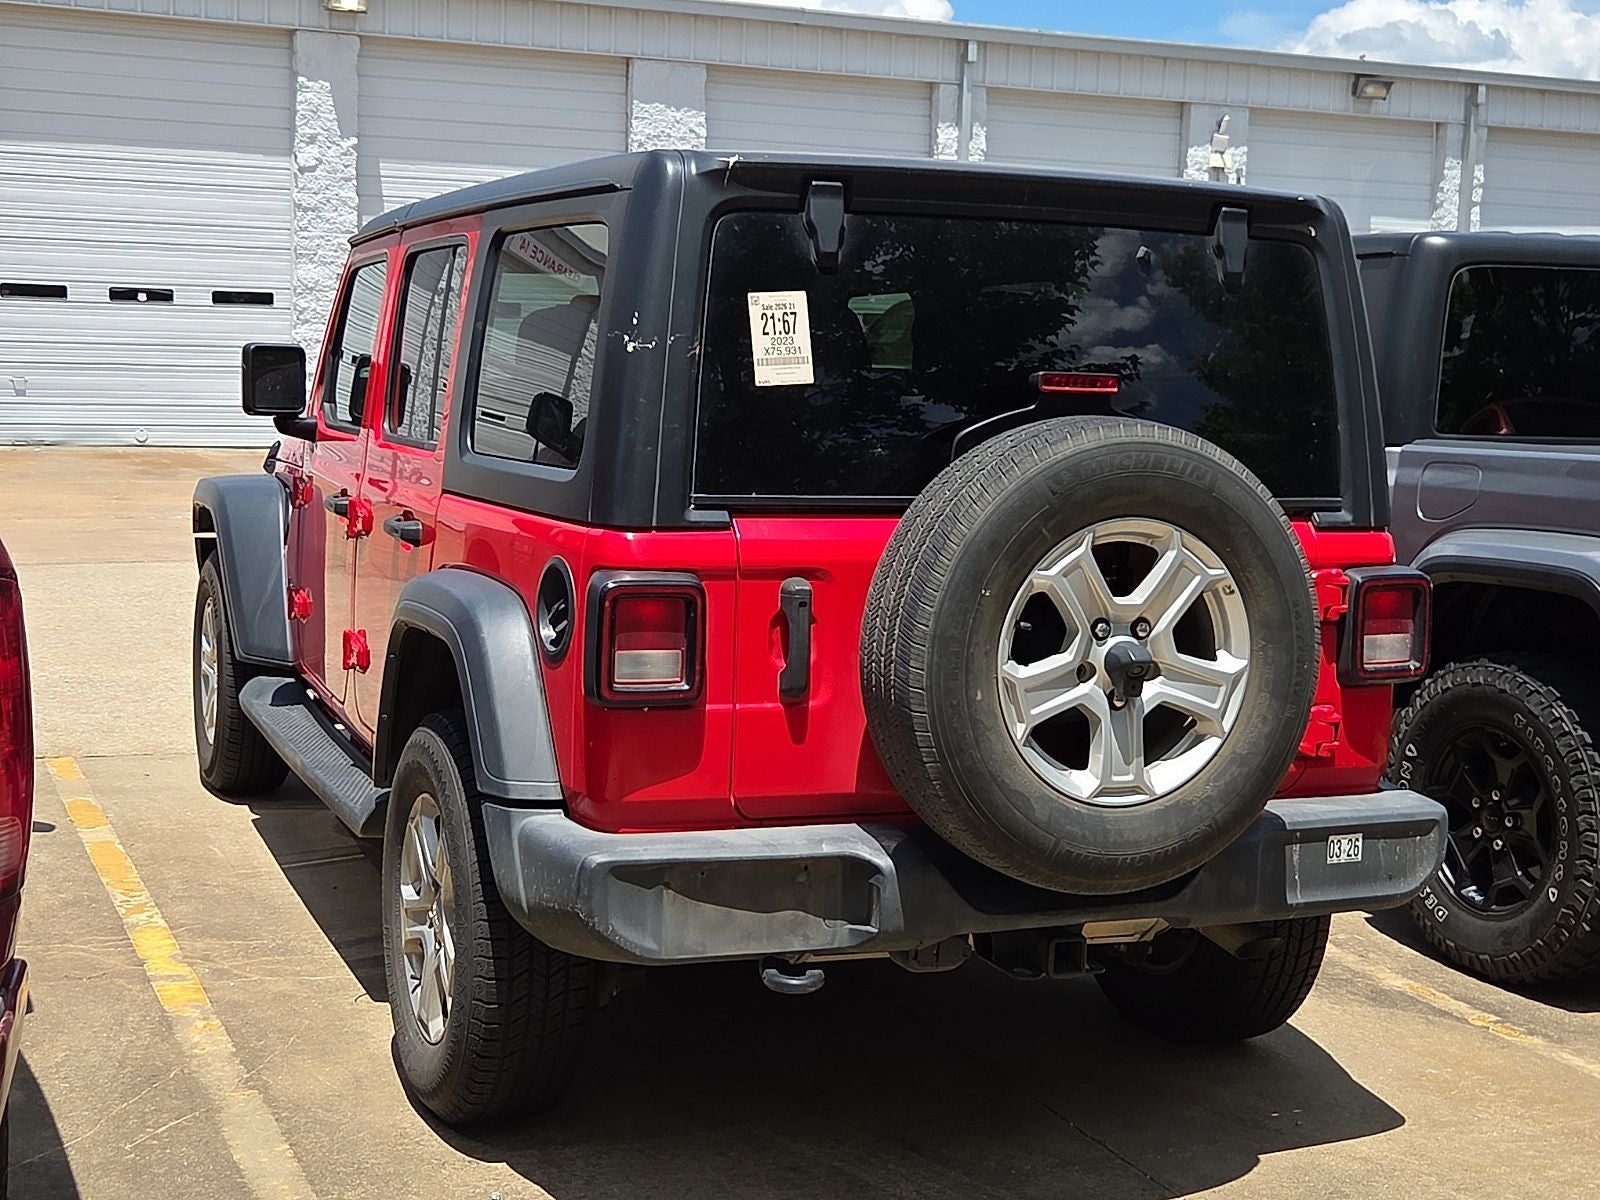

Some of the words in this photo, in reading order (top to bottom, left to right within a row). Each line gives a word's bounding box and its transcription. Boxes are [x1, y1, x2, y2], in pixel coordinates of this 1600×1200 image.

[760, 312, 797, 336] 21:67
[770, 336, 795, 346] 2023
[1081, 453, 1211, 484] MICHELIN
[1328, 839, 1342, 859] 03
[1346, 838, 1360, 857] 26
